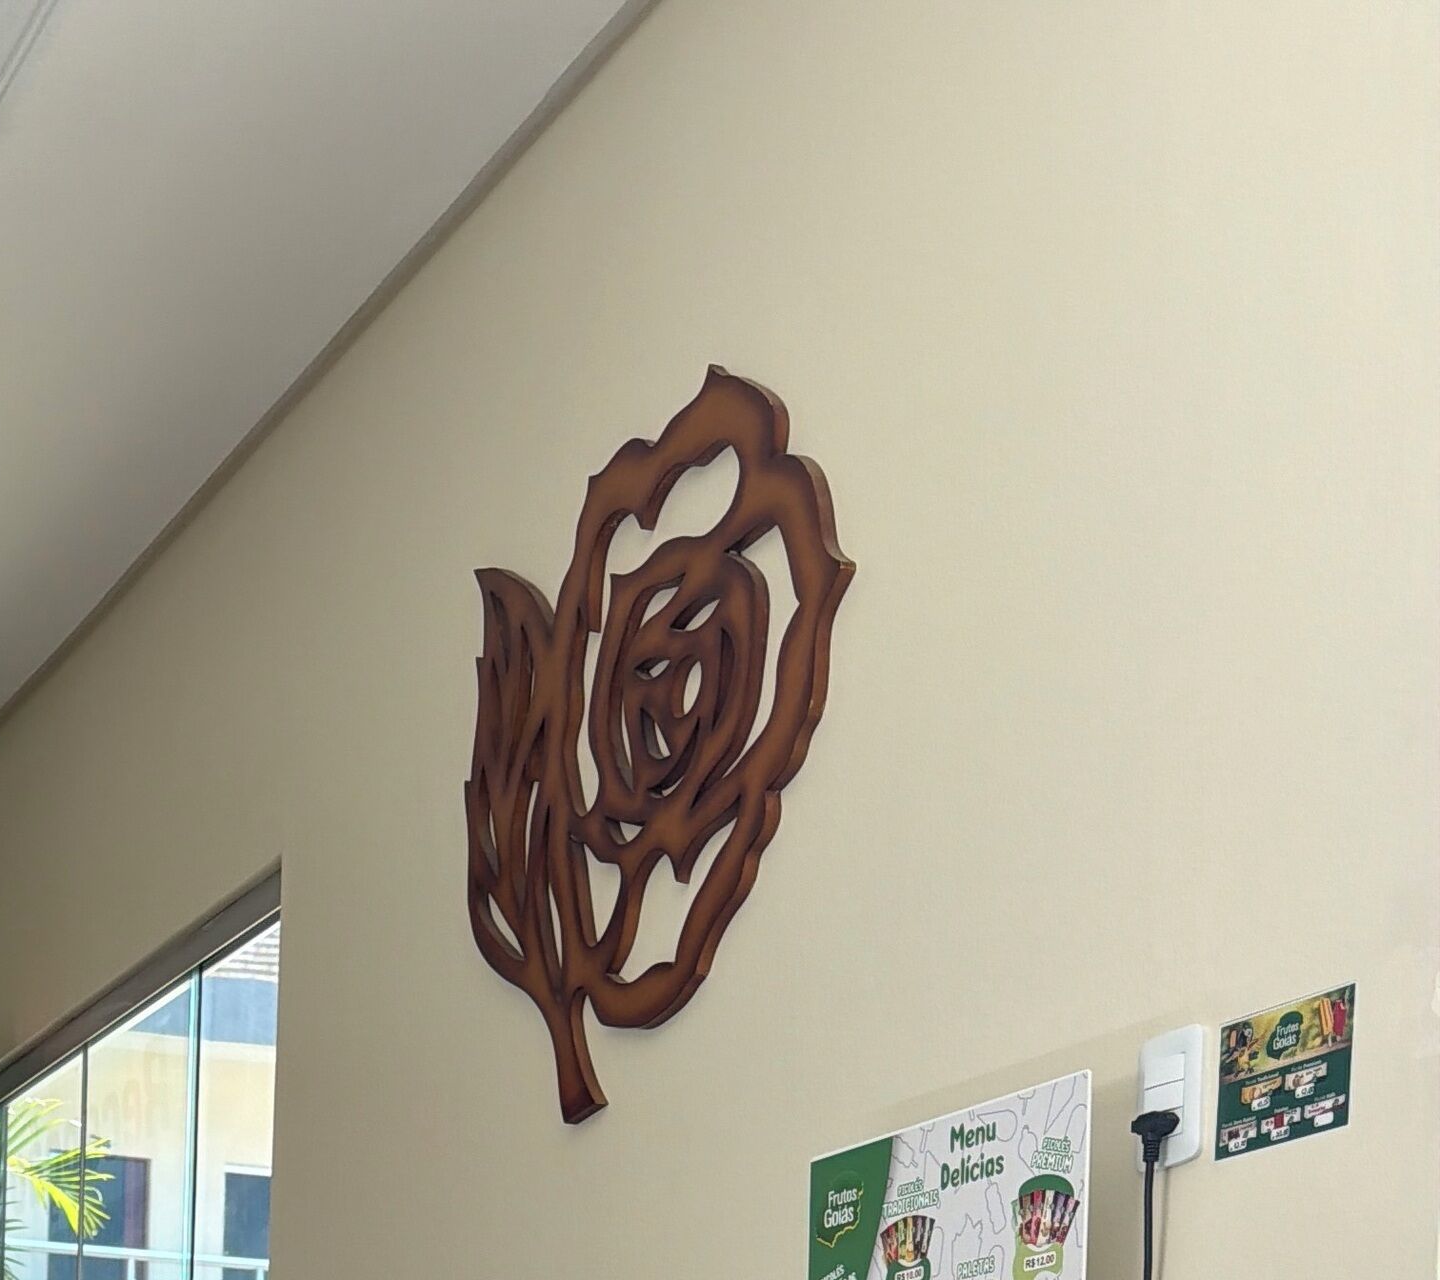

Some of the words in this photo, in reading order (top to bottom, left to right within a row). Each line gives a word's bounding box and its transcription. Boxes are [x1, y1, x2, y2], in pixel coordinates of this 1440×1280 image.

[1276, 1022, 1299, 1039] Frutos
[950, 1122, 996, 1153] Menu
[940, 1152, 1004, 1191] Delícias
[1030, 1150, 1074, 1174] PREMIUM
[828, 1188, 857, 1208] Frutos
[823, 1204, 854, 1229] Goiás
[956, 1254, 995, 1280] PALETAS
